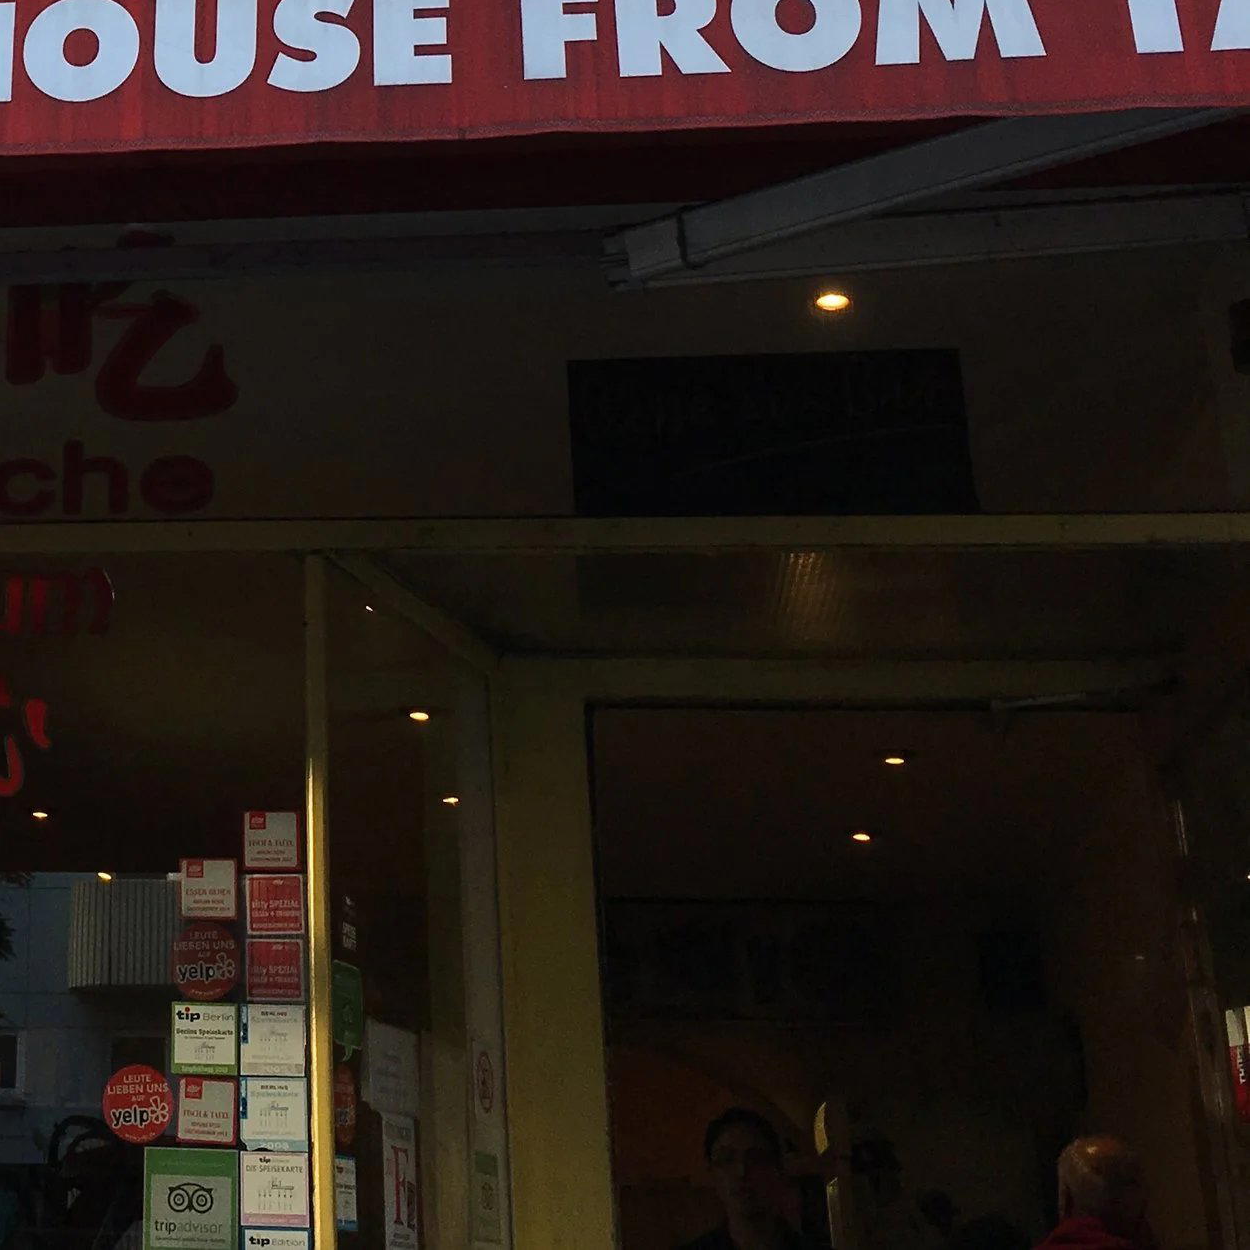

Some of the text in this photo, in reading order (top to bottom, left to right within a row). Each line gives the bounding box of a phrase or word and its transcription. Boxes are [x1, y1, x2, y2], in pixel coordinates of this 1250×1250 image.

[177, 961, 217, 984] yelp
[176, 1006, 234, 1023] tip Berlin
[123, 1074, 151, 1084] LEUTE
[107, 1082, 170, 1095] LIEBEN UNS
[111, 1105, 151, 1129] yelp
[154, 1219, 224, 1235] tripadvisor
[249, 1235, 306, 1247] tip Edition
